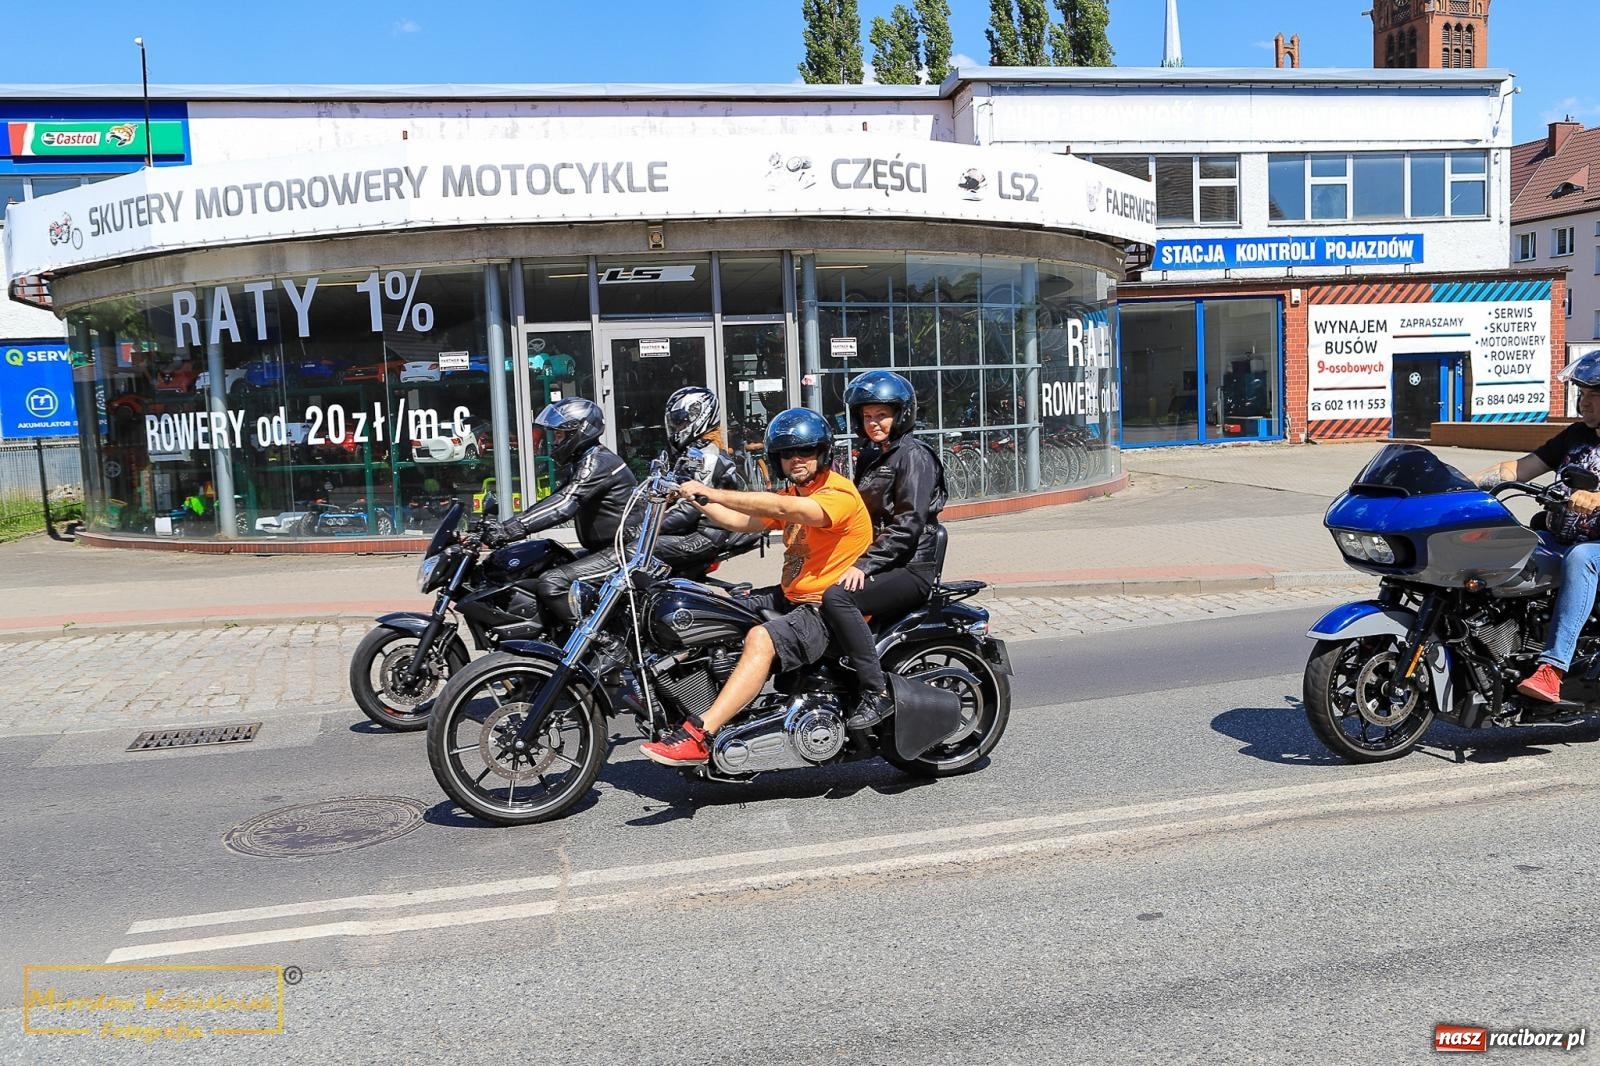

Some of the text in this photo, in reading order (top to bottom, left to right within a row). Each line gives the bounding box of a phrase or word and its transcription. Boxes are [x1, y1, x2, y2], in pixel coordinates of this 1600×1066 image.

[56, 133, 97, 145] Castrol
[89, 190, 183, 238] SKUTERY
[195, 165, 428, 220] MOTOROWERY
[442, 161, 669, 198] MOTOCYKLE
[831, 152, 927, 197] CZĘŚCI
[997, 170, 1039, 202] LS2
[1161, 236, 1414, 266] STACJA KONTROLI POJAZDÓW
[172, 269, 434, 348] RATY 1%
[1494, 307, 1533, 319] SERWIS
[1314, 319, 1388, 335] WYNAJEM
[1400, 317, 1464, 328] ZAPRASZAMY
[1489, 321, 1537, 333] SKUTERY
[1325, 336, 1378, 354] BUSÓW
[1480, 335, 1546, 347] MOTOROWERY
[1490, 349, 1536, 361] ROWERY
[1317, 360, 1384, 375] 9-osobowych
[1494, 363, 1532, 377] QUADY
[1042, 381, 1099, 417] ROWERY
[1324, 398, 1386, 411] 602 111 553
[1487, 392, 1545, 405] 884 049 292
[18, 420, 71, 429] AKUMULATOR
[145, 409, 246, 452] ROWERY
[257, 406, 287, 447] od
